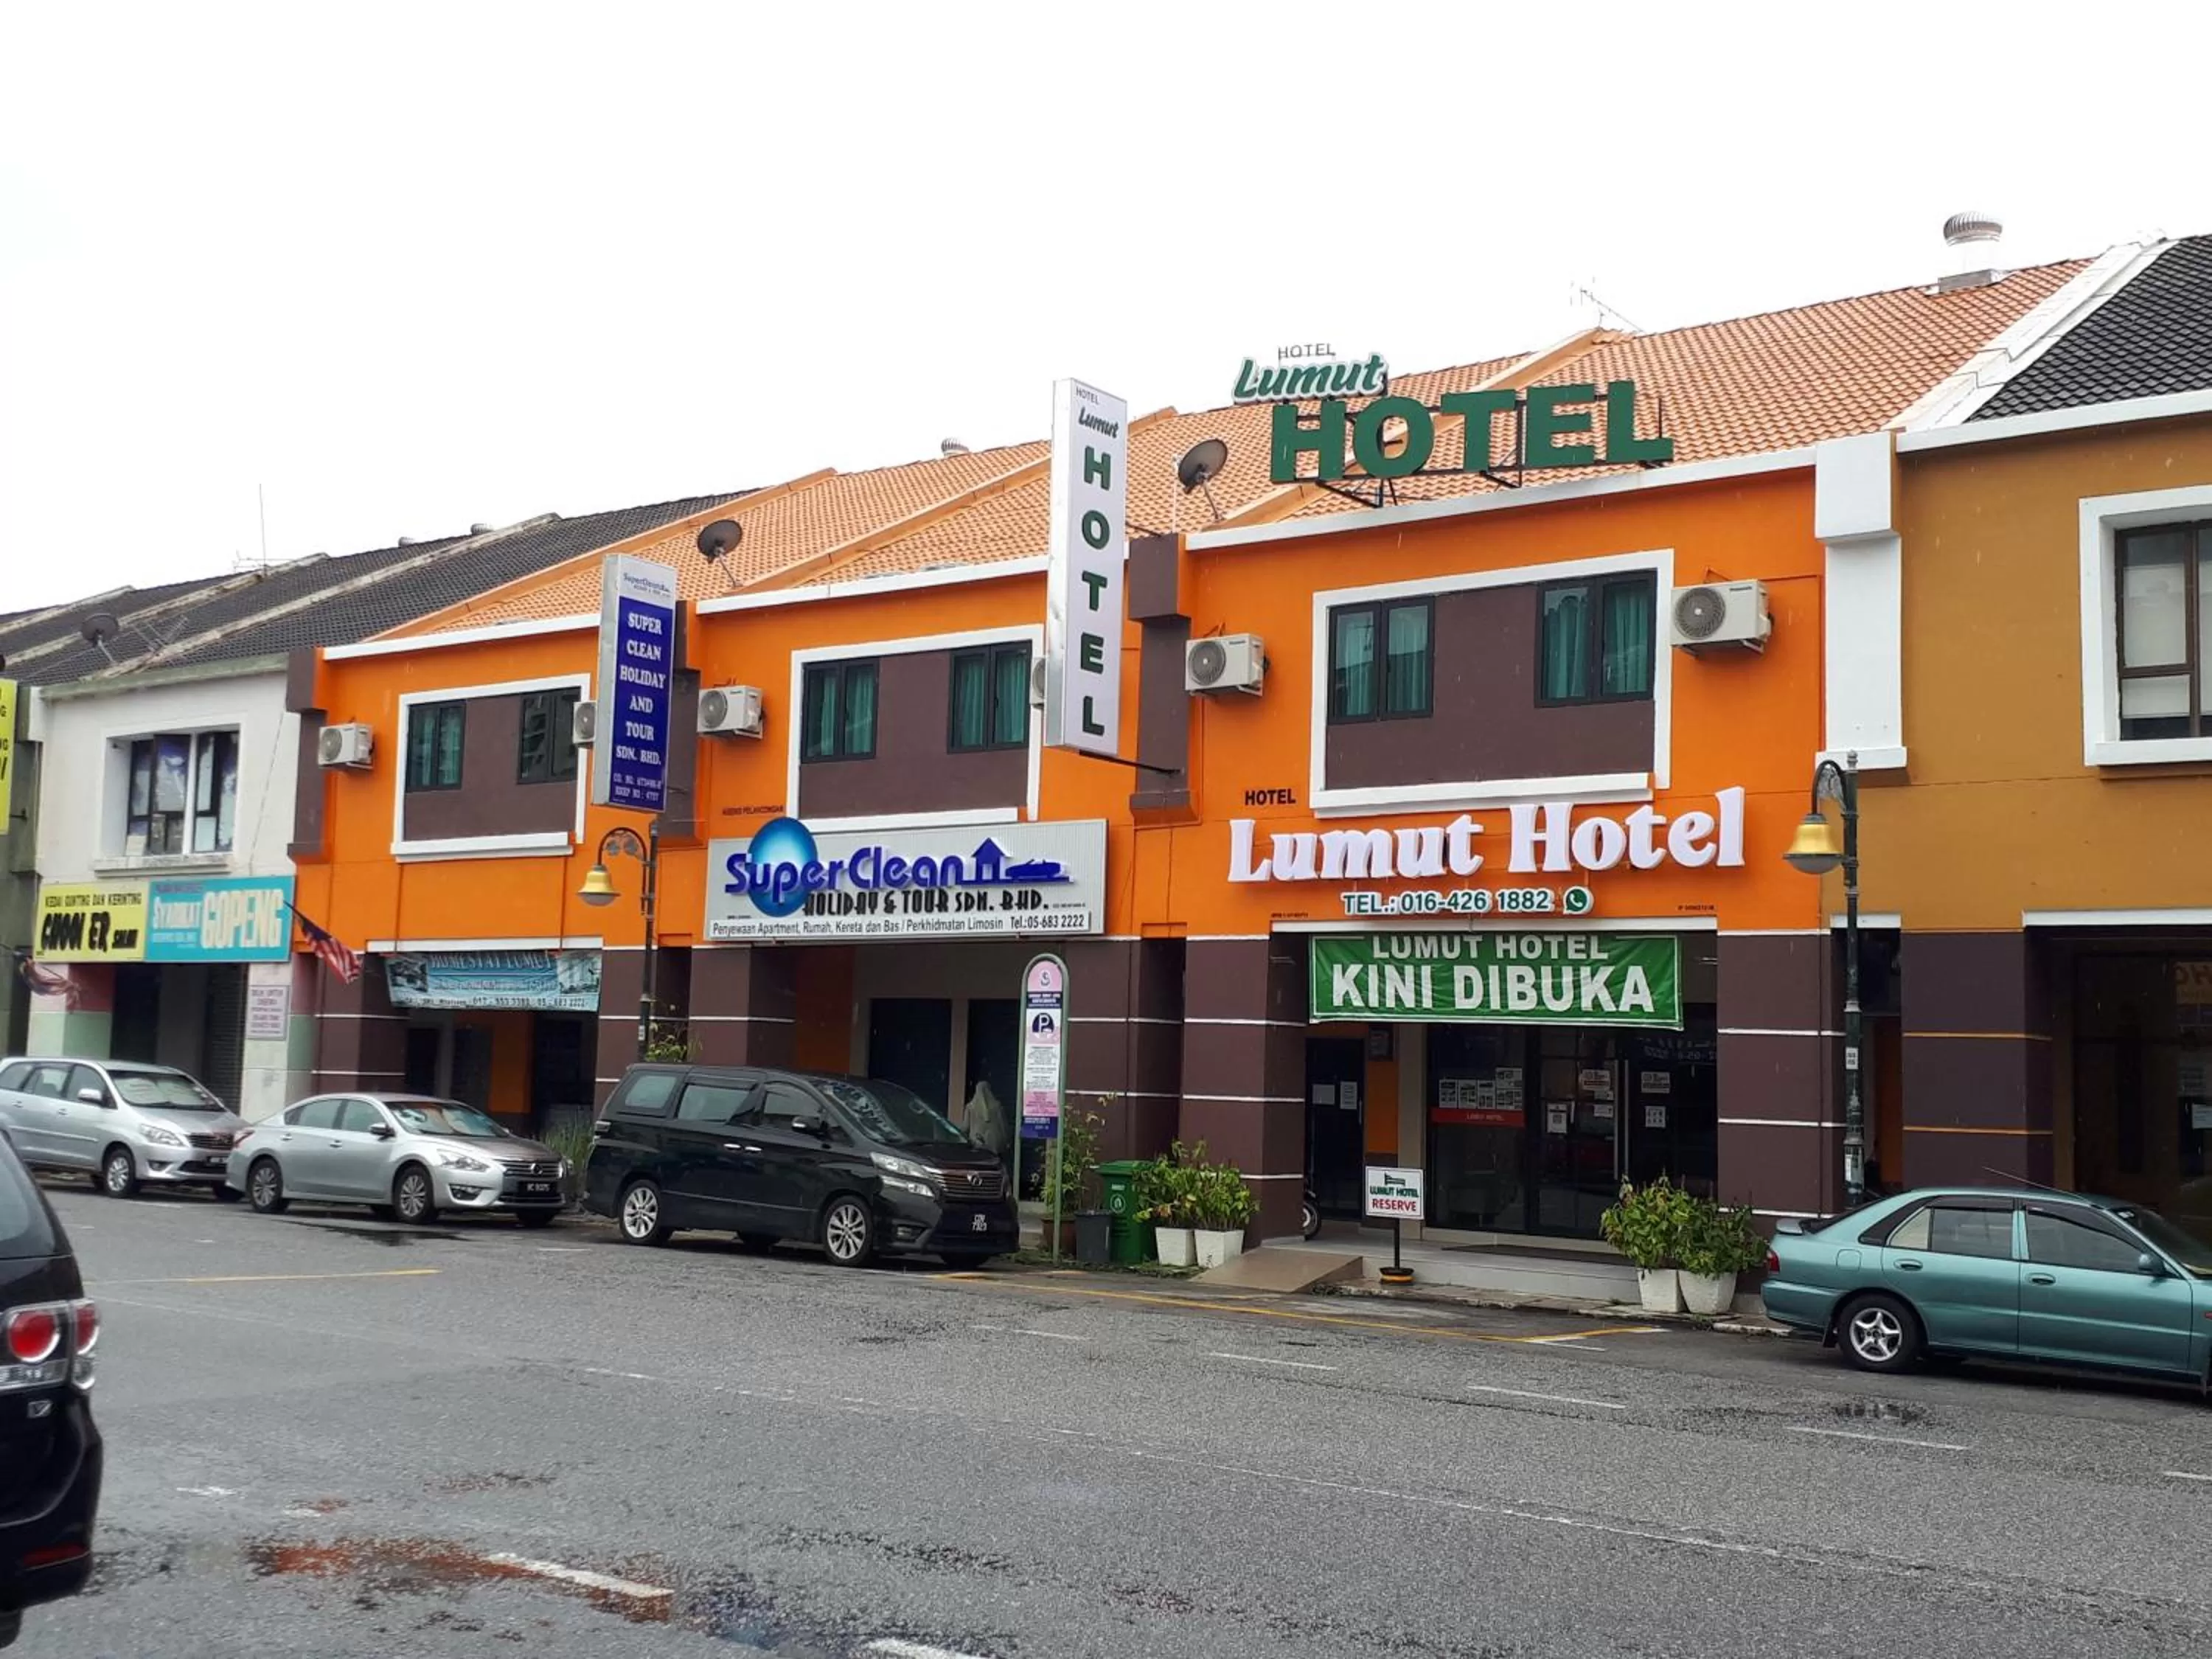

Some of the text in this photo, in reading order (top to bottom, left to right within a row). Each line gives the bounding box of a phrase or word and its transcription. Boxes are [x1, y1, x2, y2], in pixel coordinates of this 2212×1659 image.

[1278, 344, 1335, 359] HOTEL
[1232, 354, 1386, 401] Lumut
[1077, 386, 1099, 405] HOTEL
[1078, 406, 1119, 439] Lumut
[1270, 380, 1674, 481] HOTEL
[1080, 445, 1111, 736] HOTEL
[627, 612, 662, 635] SUPER
[627, 639, 661, 661] CLEAN
[619, 664, 666, 689] HOLIDAY
[629, 695, 653, 713] AND
[625, 720, 654, 741] TOUR
[616, 745, 661, 765] SDN. BHD.
[1244, 788, 1296, 806] HOTEL
[1228, 786, 1746, 883] Lumut Hotel
[725, 846, 964, 903] SuperClean
[45, 896, 61, 907] KEDAI
[92, 894, 105, 905] DAN
[803, 888, 1048, 916] HOLIDAY & TOUR SDN. BHD.
[1498, 890, 1549, 909] 1882
[713, 922, 756, 937] Penyewaan
[758, 922, 799, 936] Apartment,
[803, 921, 832, 933] Rumah,
[835, 920, 862, 933] Kereta
[866, 919, 881, 932] dan
[884, 919, 899, 932] Bas
[907, 917, 964, 931] Perkhidmatan
[967, 917, 1004, 930] Limosin
[1061, 914, 1085, 928] 2222
[1372, 934, 1609, 959] LUMUT HOTEL
[1332, 964, 1655, 1013] KINI DIBUKA
[1370, 1186, 1419, 1198] LUMUT HOTEL
[1372, 1198, 1416, 1211] RESERVE
